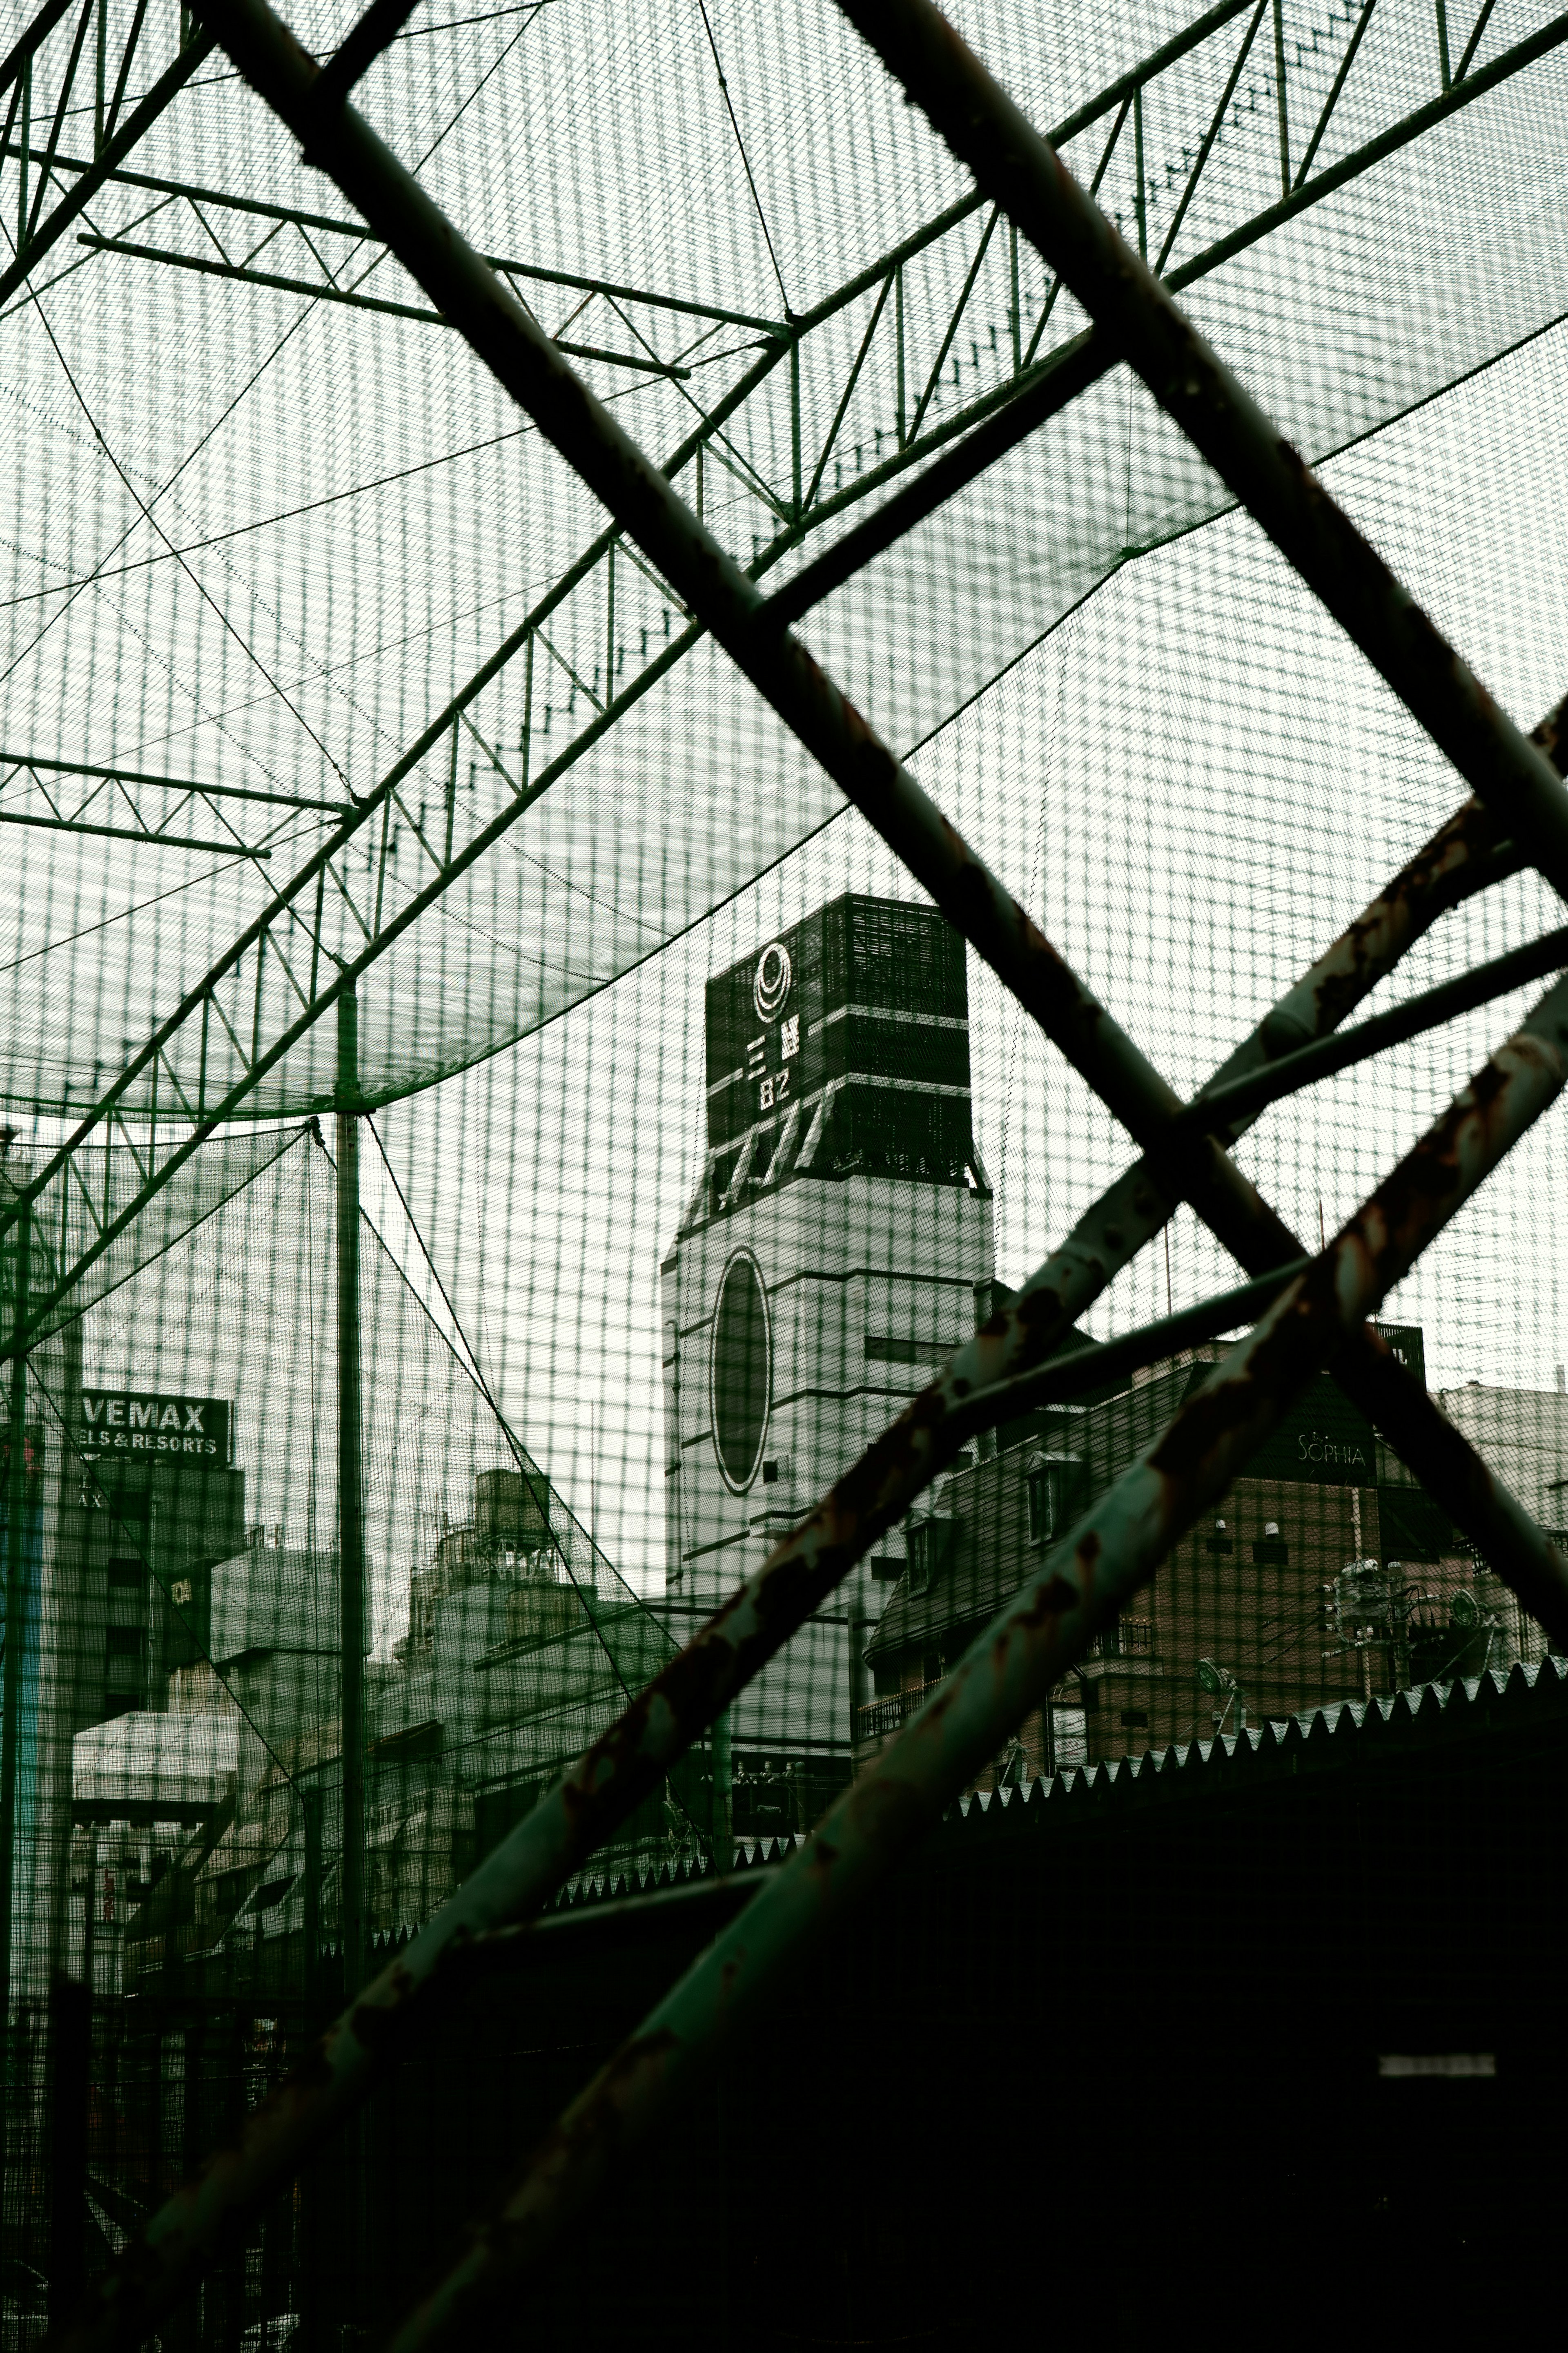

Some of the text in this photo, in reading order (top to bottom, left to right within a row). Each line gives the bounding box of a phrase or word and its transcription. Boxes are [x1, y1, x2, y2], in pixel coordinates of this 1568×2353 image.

[760, 1066, 790, 1111] 82
[82, 1397, 205, 1433] VEMAX
[114, 1432, 128, 1447] &
[132, 1433, 217, 1454] RESORTS
[1298, 1434, 1366, 1466] SOPHIA
